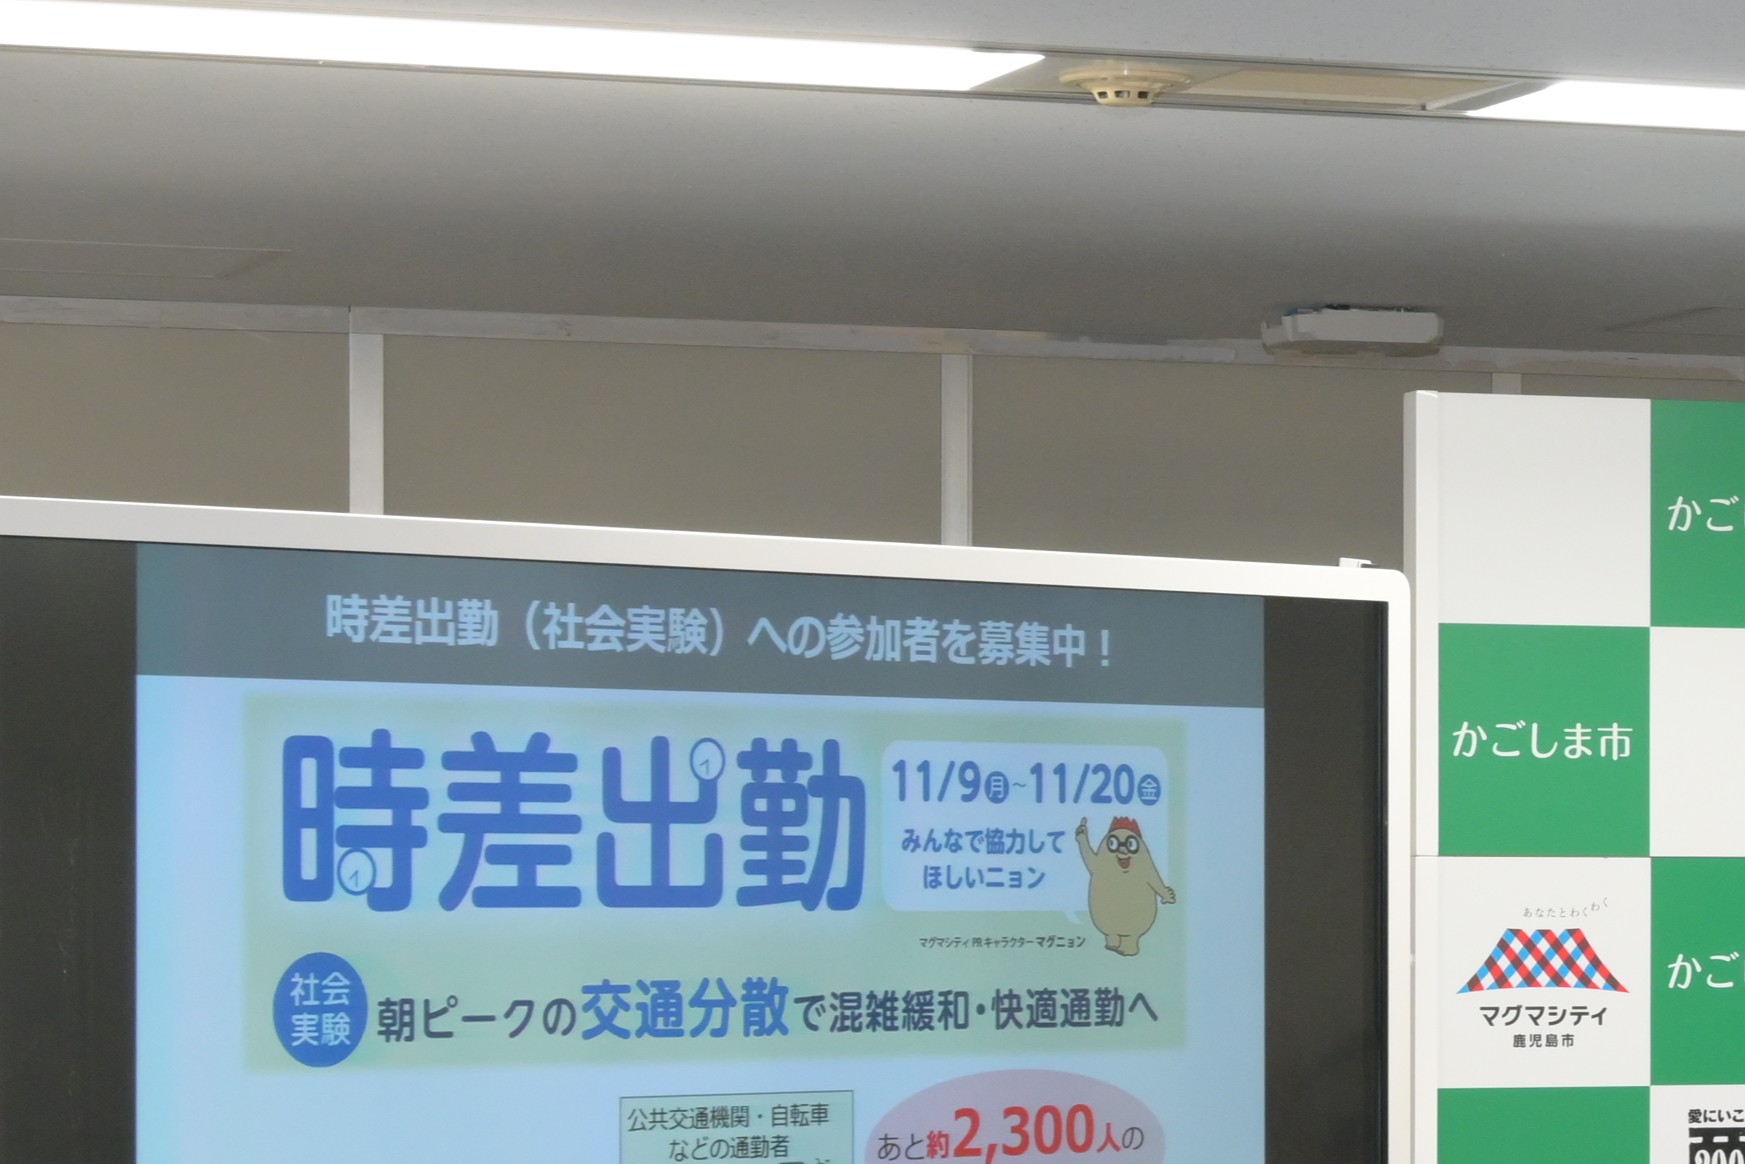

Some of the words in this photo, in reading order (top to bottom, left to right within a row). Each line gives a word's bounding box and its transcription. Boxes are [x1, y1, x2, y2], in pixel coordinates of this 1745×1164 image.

[1453, 720, 1633, 761] かごしま市
[283, 728, 867, 912] 時差出勤
[902, 828, 1066, 854] みんなで協力して
[924, 865, 1045, 889] ほしいニョン
[1522, 897, 1609, 917] あなたとわくわく
[290, 972, 351, 1006] 社会
[1480, 1005, 1607, 1026] マグマシティ
[290, 1012, 351, 1047] 実験
[1513, 1034, 1574, 1048] 鹿児島市
[669, 1134, 790, 1161] などの通勤者
